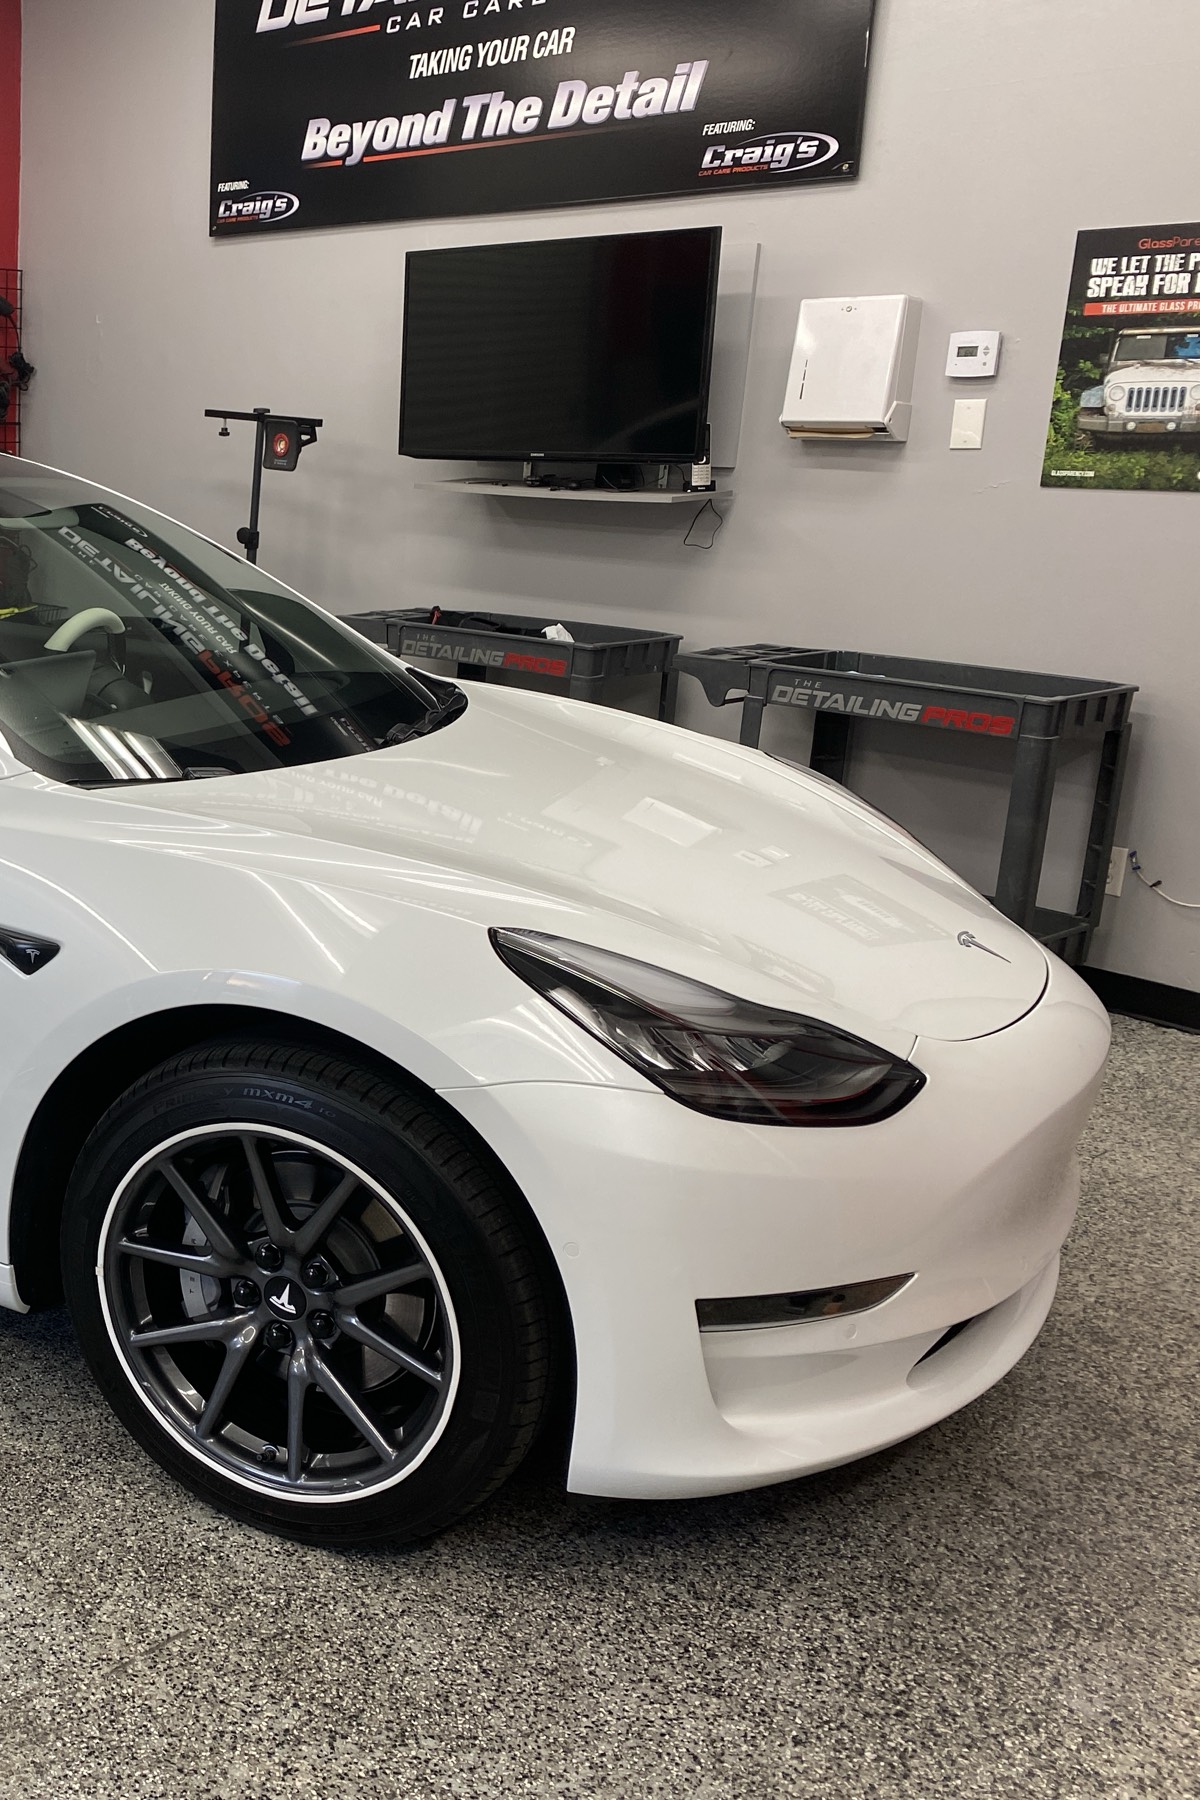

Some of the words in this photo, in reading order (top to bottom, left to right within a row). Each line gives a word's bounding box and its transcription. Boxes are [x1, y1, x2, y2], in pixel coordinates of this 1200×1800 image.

[386, 7, 444, 34] CAR
[462, 0, 548, 19] CAR
[409, 45, 475, 79] TAKING
[477, 34, 537, 69] YOUR
[533, 26, 576, 59] CAR
[301, 98, 457, 167] Beyond
[461, 90, 544, 141] The
[547, 60, 710, 129] Detail
[702, 119, 756, 136] FEATURING:
[701, 137, 819, 169] Craig's
[732, 164, 768, 173] PRODUCTS
[218, 195, 287, 219] Craig's
[1090, 257, 1118, 276] WE
[1120, 255, 1151, 274] LET
[1154, 253, 1186, 272] THE
[1086, 275, 1150, 298] SPEAK
[1152, 273, 1192, 295] FOR
[1102, 304, 1117, 313] THE
[1119, 302, 1158, 313] ULTIMATE
[1160, 301, 1185, 311] GLASS
[1187, 300, 1200, 310] PR
[416, 633, 436, 642] THE
[402, 639, 504, 666] DETAILING
[794, 678, 822, 688] THE
[771, 685, 923, 721] DETAILING
[920, 705, 1015, 736] PROS
